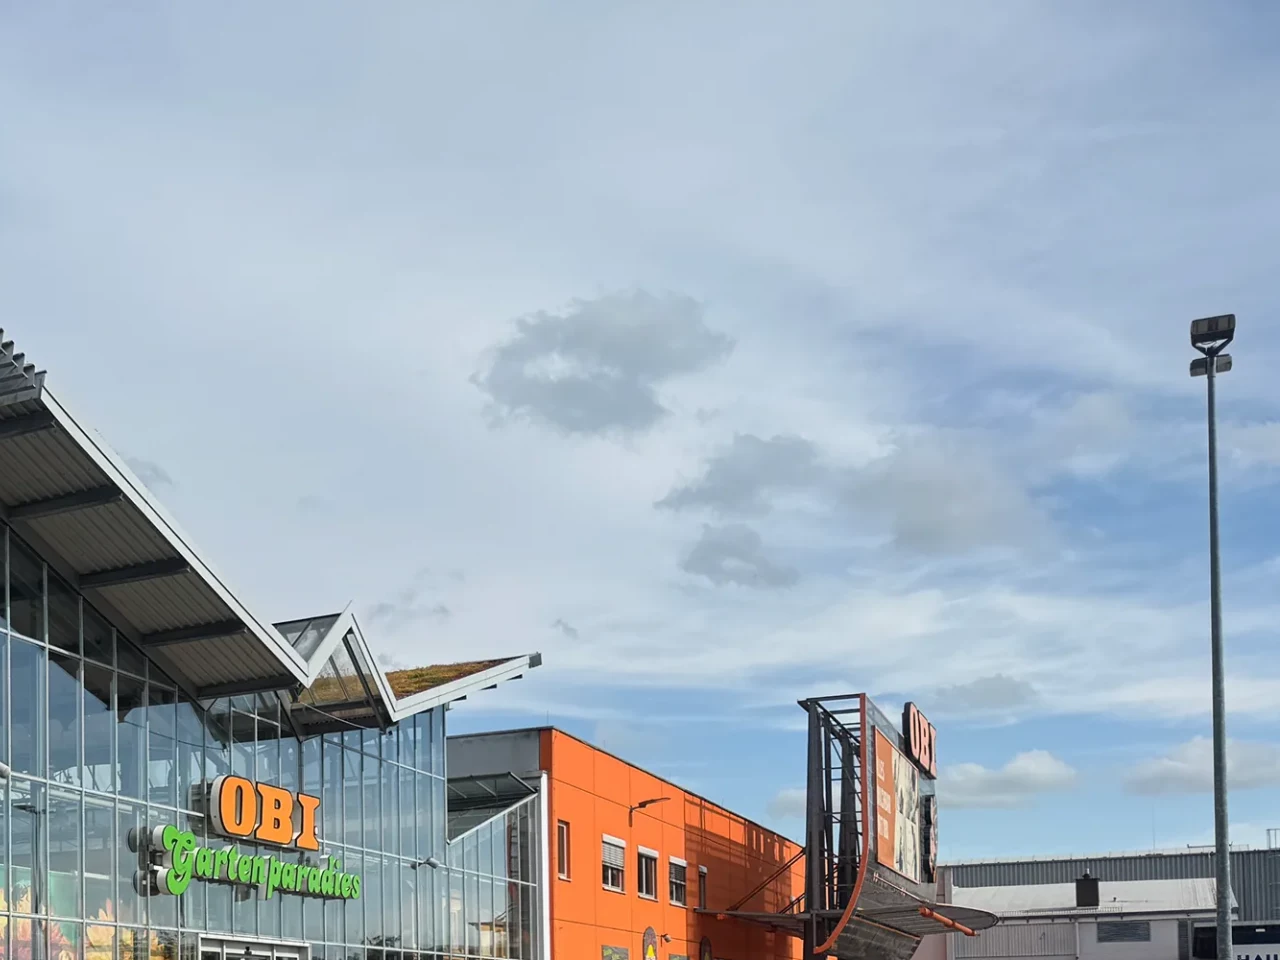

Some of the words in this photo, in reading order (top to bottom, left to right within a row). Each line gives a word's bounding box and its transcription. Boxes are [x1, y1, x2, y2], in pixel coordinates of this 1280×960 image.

[909, 702, 937, 779] OBI
[219, 775, 320, 851] OBI
[161, 824, 361, 900] Gartenparadies
